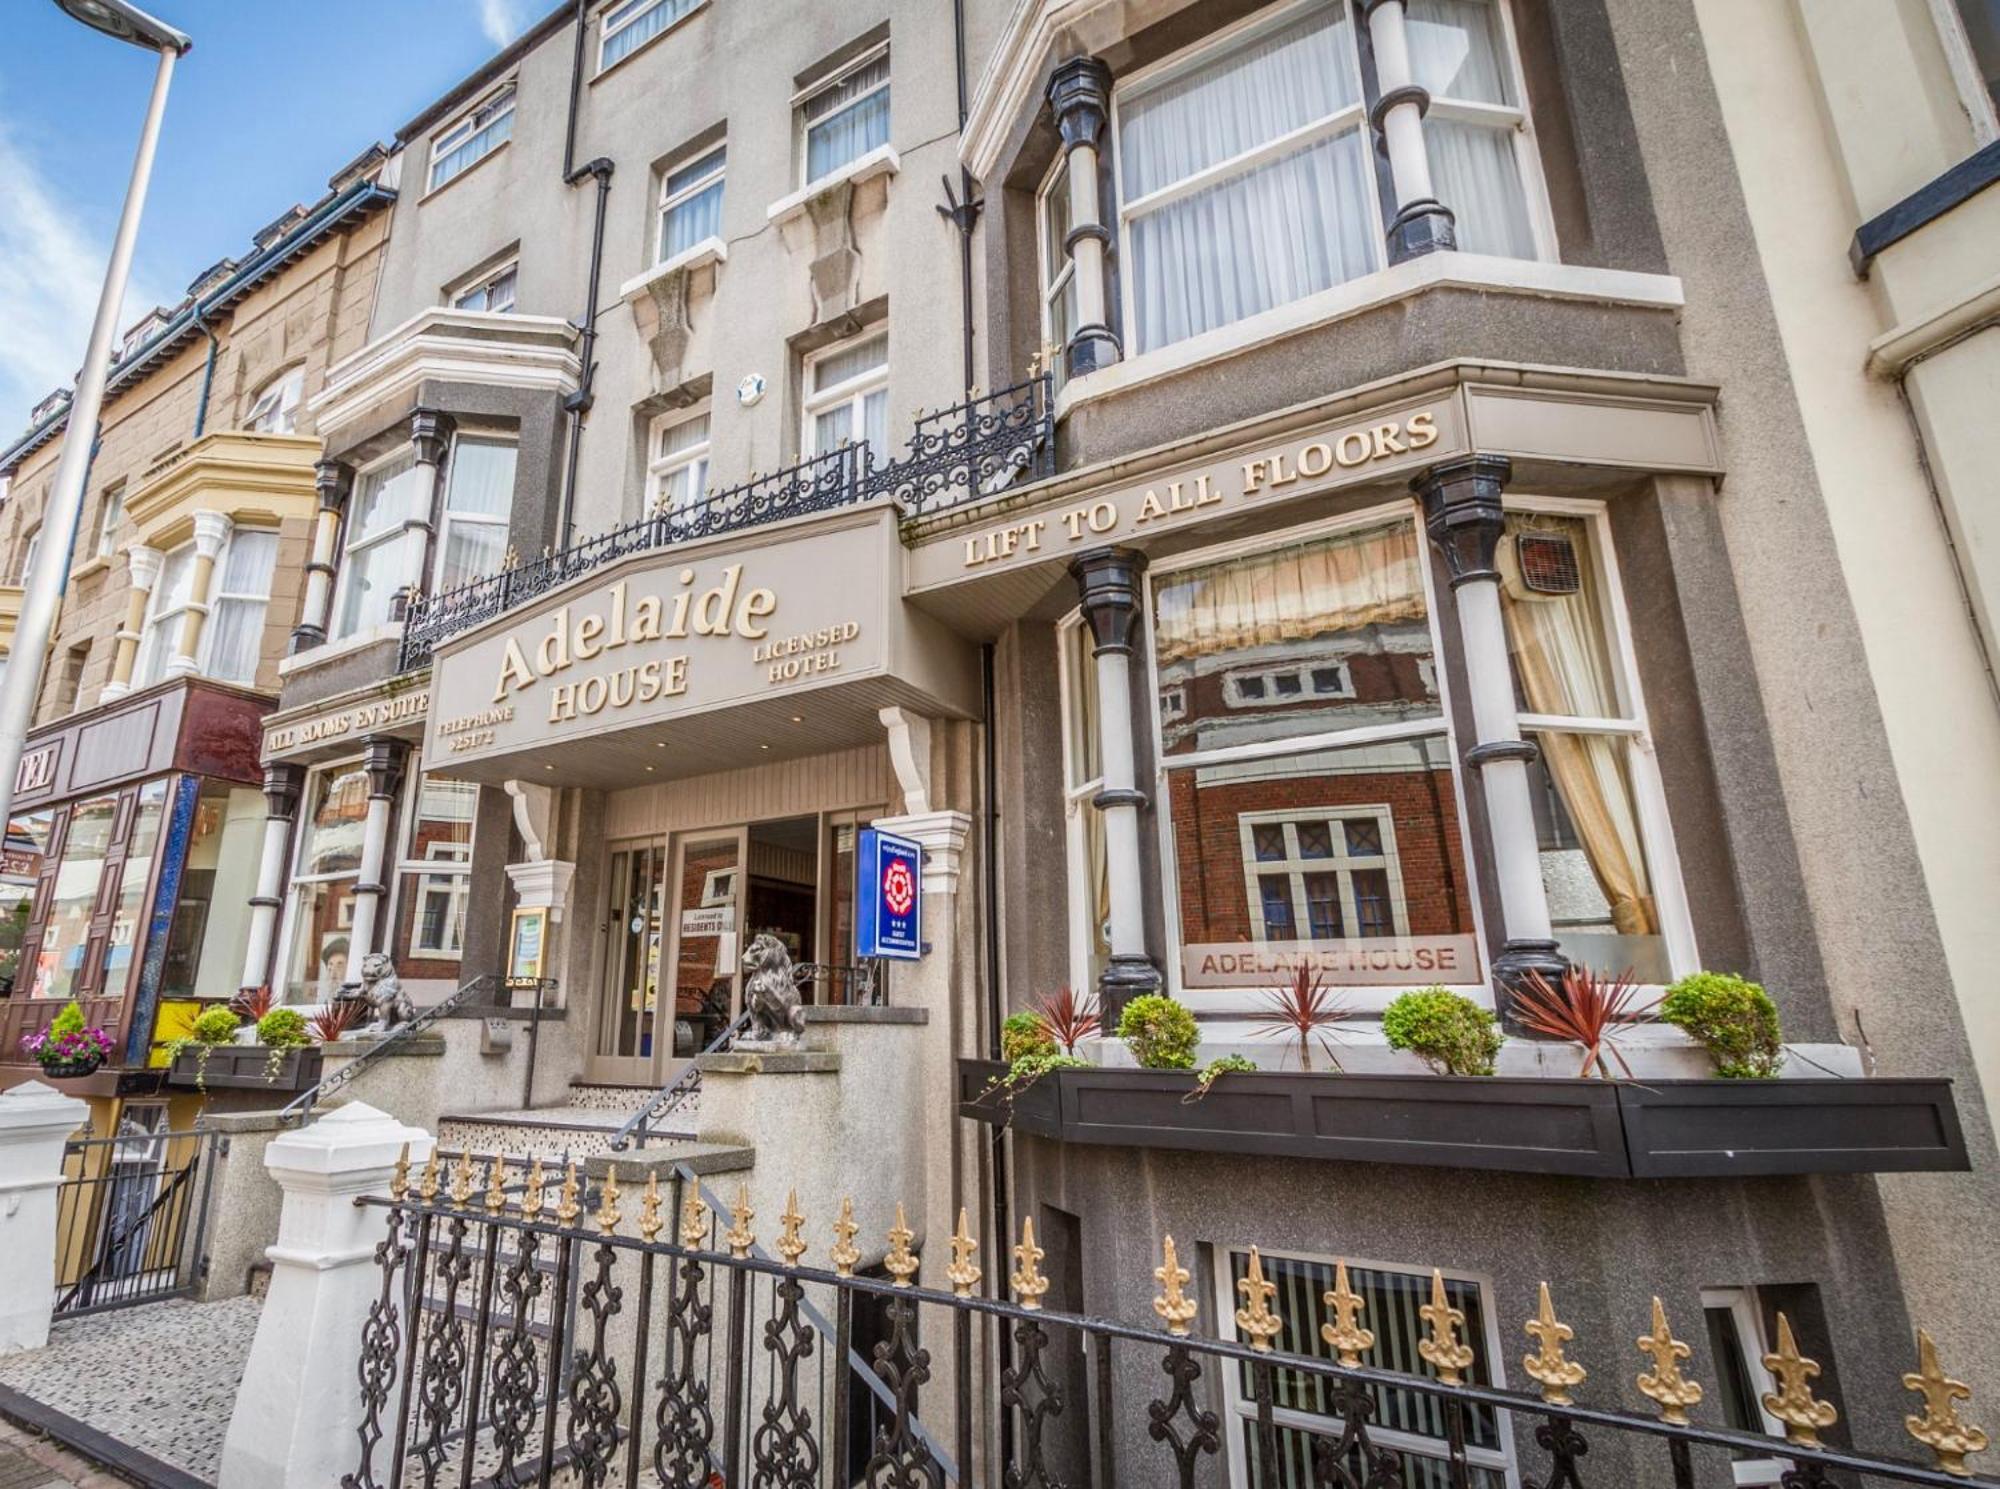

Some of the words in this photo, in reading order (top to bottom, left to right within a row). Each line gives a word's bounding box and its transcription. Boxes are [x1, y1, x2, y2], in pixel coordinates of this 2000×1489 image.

[963, 521, 1045, 566] LIFT
[1061, 502, 1118, 541] TO
[1136, 475, 1222, 522] ALL
[1242, 412, 1440, 495] FLOORS
[491, 563, 777, 703] Adelaide
[753, 621, 860, 664] LICENSED
[549, 655, 689, 723] HOUSE
[768, 650, 841, 683] HOTEL
[268, 731, 295, 752] ALL
[300, 716, 351, 744] ROOMS
[356, 707, 378, 729] EN
[381, 692, 430, 723] SUITE
[437, 705, 513, 736] TELEPHONE
[1349, 948, 1457, 971] HOUSE
